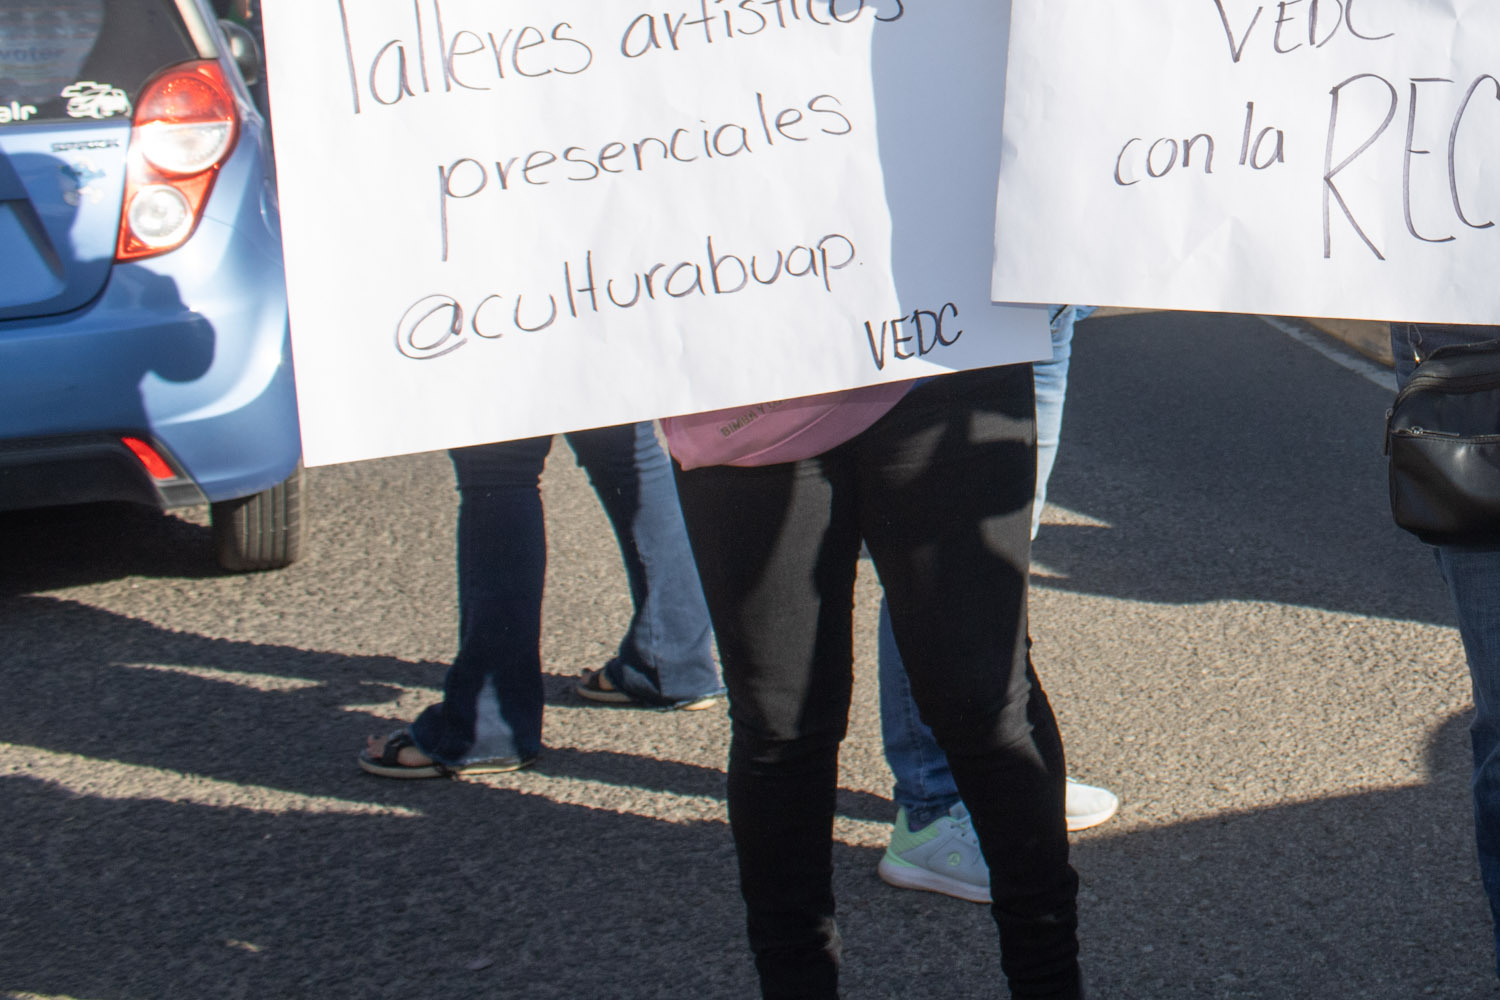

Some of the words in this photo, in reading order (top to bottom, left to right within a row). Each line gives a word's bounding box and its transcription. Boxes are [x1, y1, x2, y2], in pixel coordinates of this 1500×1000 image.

[437, 92, 856, 262] presenciales
[1113, 133, 1215, 187] con
[1238, 101, 1285, 170] la
[863, 302, 963, 371] VEDC
